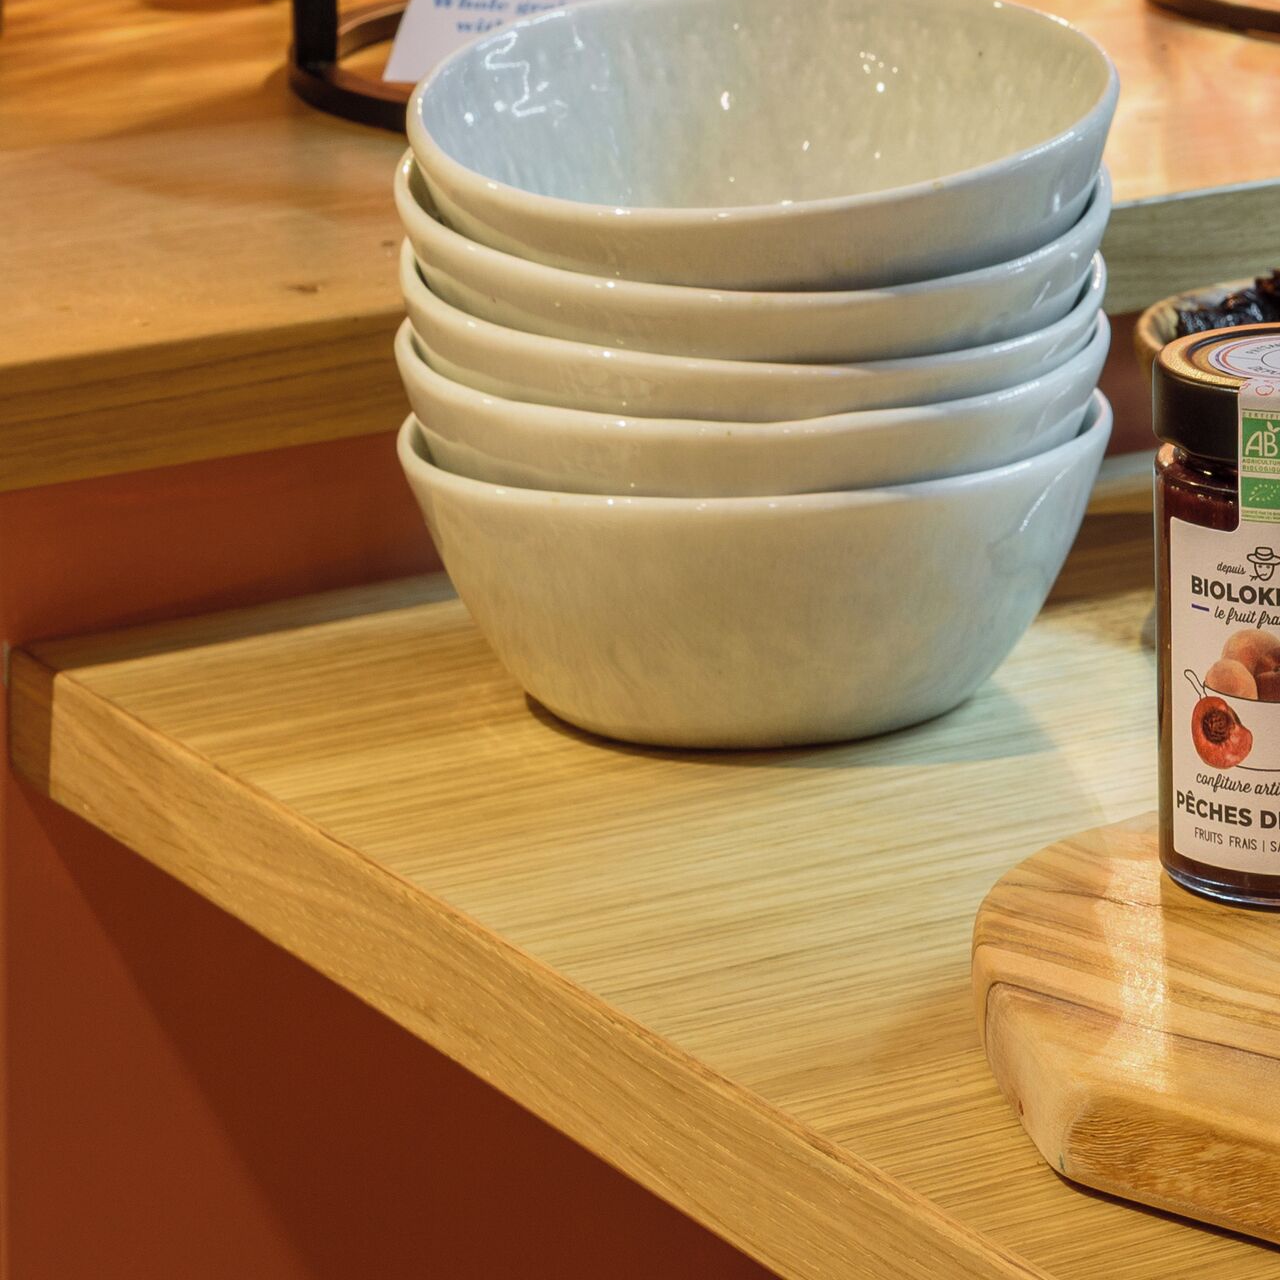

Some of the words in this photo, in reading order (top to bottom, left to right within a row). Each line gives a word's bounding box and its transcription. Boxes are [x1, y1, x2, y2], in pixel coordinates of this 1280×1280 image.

[1245, 431, 1279, 458] AB
[1217, 561, 1246, 575] depuis
[1214, 606, 1225, 619] le
[1226, 608, 1257, 625] fruit
[1196, 772, 1251, 793] confiture
[1176, 789, 1253, 827] PÊCHES
[1195, 827, 1223, 845] FRUITS
[1229, 835, 1257, 851] FRAIS
